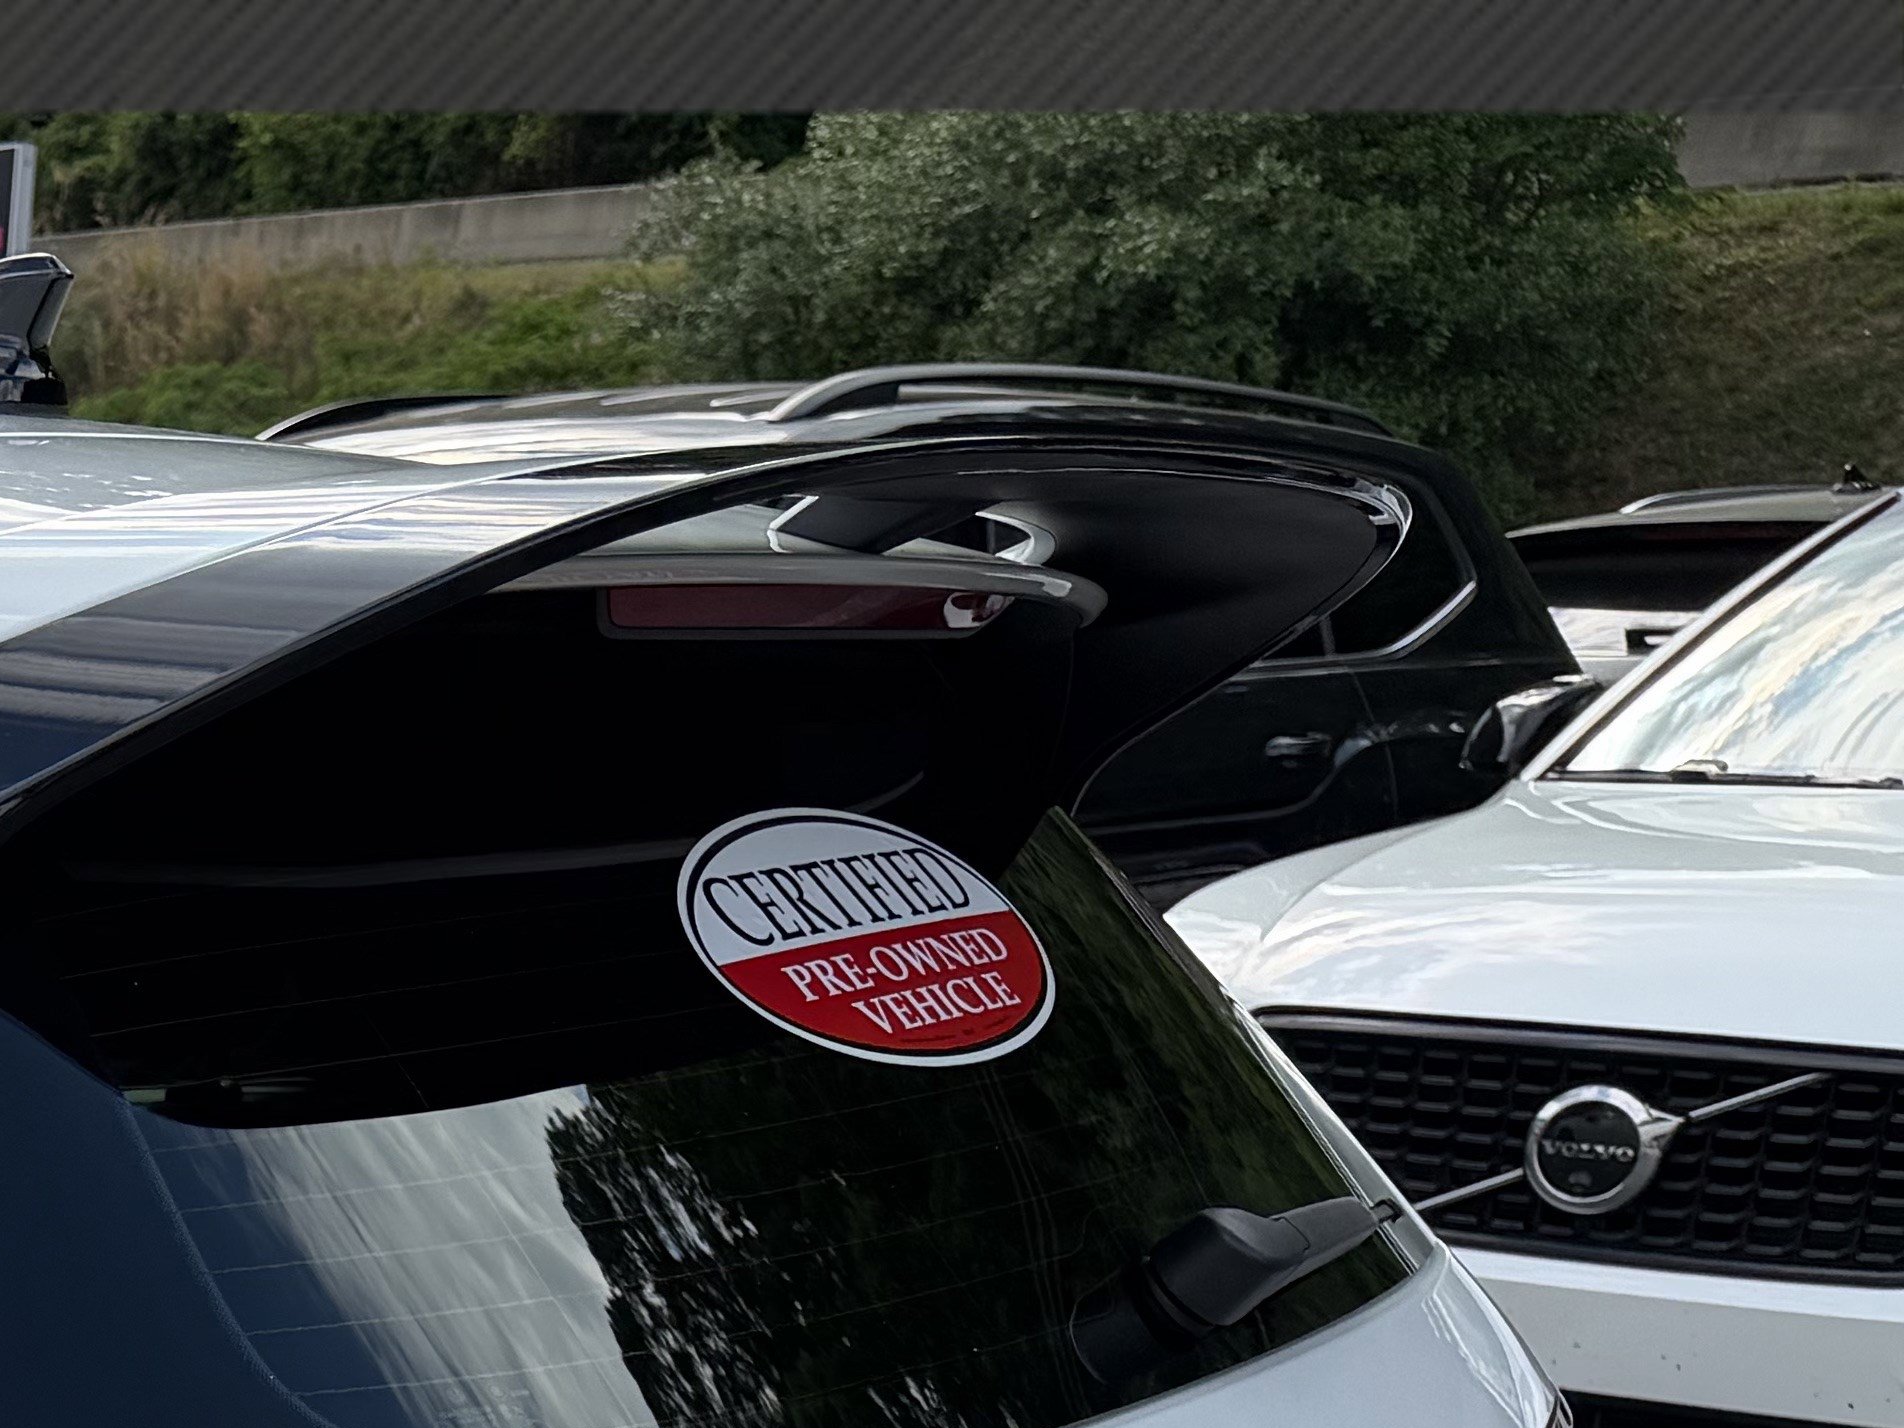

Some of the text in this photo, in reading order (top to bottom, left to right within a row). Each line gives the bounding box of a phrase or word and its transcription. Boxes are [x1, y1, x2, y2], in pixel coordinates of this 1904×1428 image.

[701, 847, 971, 946] CERTIFIED
[780, 927, 1009, 1002] PRE-OWNED
[850, 971, 1023, 1034] VEHICLE
[1540, 1139, 1636, 1163] VOLVO
